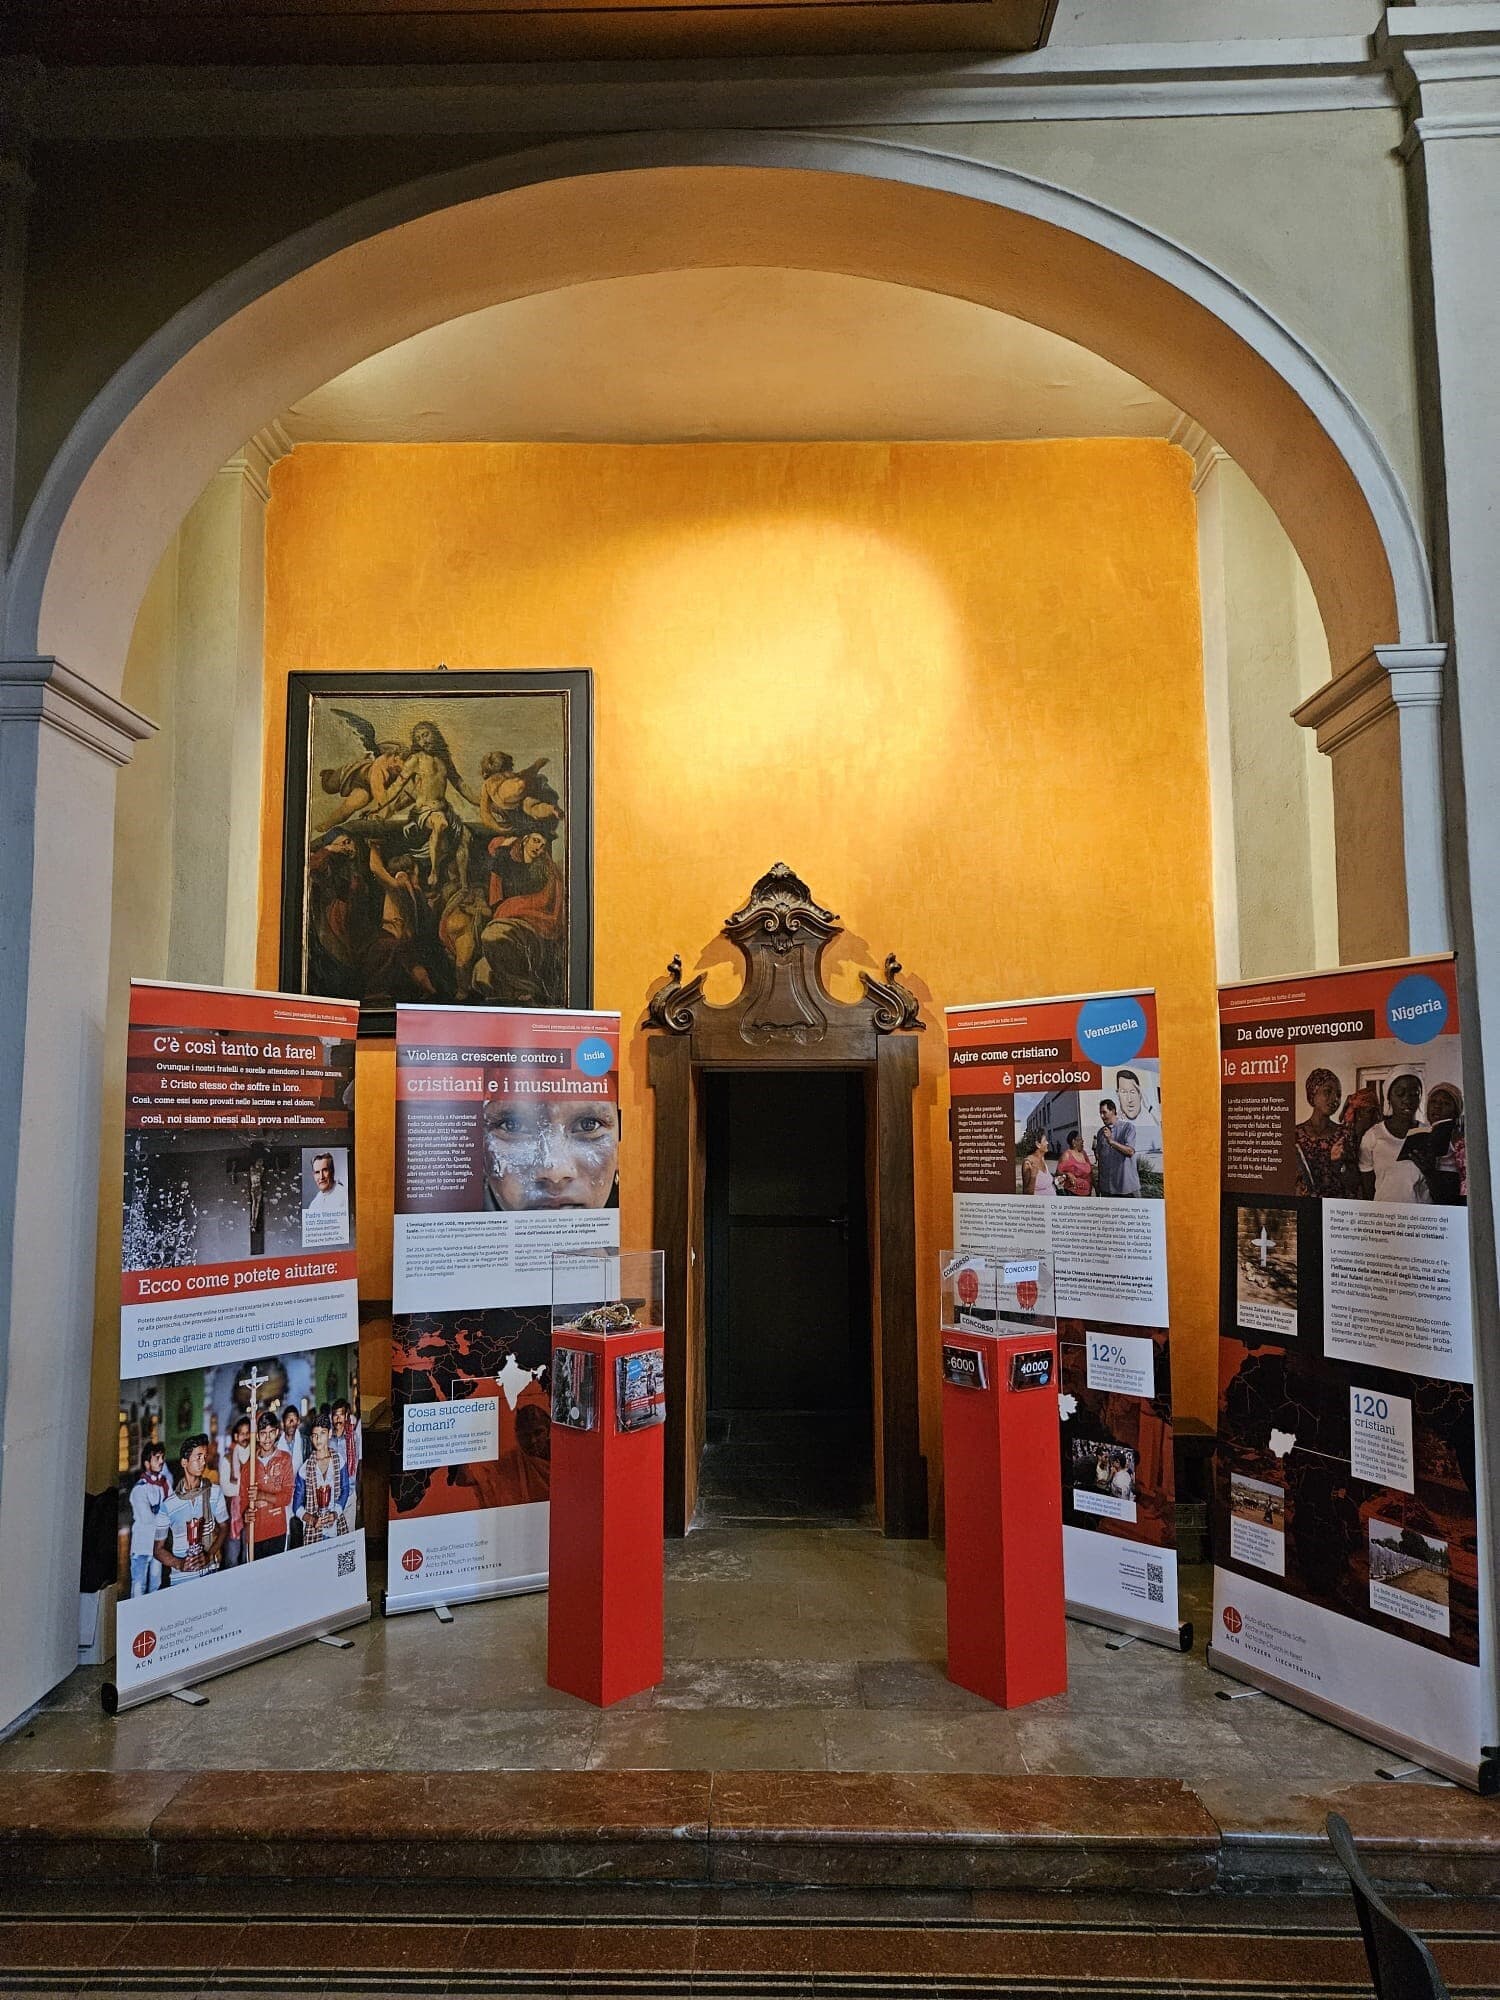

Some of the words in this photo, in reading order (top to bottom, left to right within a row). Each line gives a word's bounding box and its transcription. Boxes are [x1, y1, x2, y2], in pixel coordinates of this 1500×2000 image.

[1392, 999, 1442, 1021] Nigeria
[1084, 1019, 1138, 1039] Venezuela
[1237, 1029, 1252, 1040] Da
[1256, 1026, 1284, 1039] dove
[1288, 1021, 1364, 1040] provengono
[154, 1037, 180, 1052] C'è
[185, 1040, 216, 1054] così
[221, 1041, 258, 1056] tanto
[263, 1043, 281, 1058] da
[286, 1044, 316, 1059] fare!
[407, 1050, 458, 1061] Violenza
[462, 1053, 517, 1062] crescente
[521, 1053, 556, 1063] contro
[560, 1053, 564, 1063] i
[584, 1051, 605, 1060] India
[953, 1051, 978, 1064] Agire
[981, 1051, 1008, 1060] come
[1012, 1047, 1058, 1059] cristiano
[157, 1063, 190, 1072] Ovunque
[196, 1064, 215, 1072] nostri
[217, 1064, 238, 1072] fratelli
[1224, 1059, 1236, 1076] le
[1241, 1054, 1288, 1075] armi?
[161, 1078, 167, 1088] È
[170, 1080, 197, 1089] Cristo
[200, 1082, 227, 1090] stesso
[230, 1082, 245, 1090] che
[247, 1082, 270, 1091] soffre
[283, 1084, 301, 1092] loro.
[407, 1076, 483, 1092] cristiani
[488, 1080, 498, 1092] e
[504, 1078, 509, 1092] i
[514, 1078, 608, 1093] musulmani
[1003, 1072, 1011, 1085] è
[1016, 1069, 1090, 1088] pericoloso
[133, 1096, 152, 1104] Così,
[210, 1097, 233, 1106] provati
[141, 1114, 164, 1124] così,
[168, 1115, 181, 1123] noi
[184, 1115, 211, 1123] siamo
[214, 1115, 238, 1123] messi
[241, 1115, 256, 1123] alla
[258, 1116, 281, 1125] prova
[284, 1115, 325, 1124] nell'amore.
[944, 1256, 969, 1277] CONCORSO
[1005, 1265, 1036, 1274] CONCORSO
[139, 1279, 181, 1295] Ecco
[187, 1274, 229, 1290] come
[234, 1267, 280, 1288] potete
[285, 1263, 338, 1279] aiutare:
[138, 1340, 149, 1348] Un
[152, 1336, 180, 1347] grande
[183, 1333, 206, 1342] grazie
[246, 1324, 259, 1332] tutti
[266, 1320, 294, 1329] cristiani
[962, 1318, 993, 1333] CONCORSO
[138, 1348, 176, 1361] possiamo
[179, 1343, 211, 1354] alleviare
[214, 1338, 249, 1348] attraverso
[258, 1333, 279, 1341] vostro
[1092, 1344, 1126, 1365] 12%
[408, 1408, 435, 1418] Cosa
[439, 1401, 496, 1415] succederà
[1354, 1394, 1388, 1419] 120
[408, 1418, 455, 1432] domani?
[1355, 1418, 1395, 1435] cristiani
[458, 1563, 502, 1573] LIECHTENSTEIN
[160, 1648, 189, 1661] SVIZZERA
[194, 1629, 242, 1648] LIECHTENSTEIN
[1226, 1634, 1239, 1644] ACN
[136, 1659, 152, 1669] ACN
[1245, 1643, 1271, 1658] SVIZZERA
[1276, 1657, 1320, 1680] LIECHTENSTEIN
